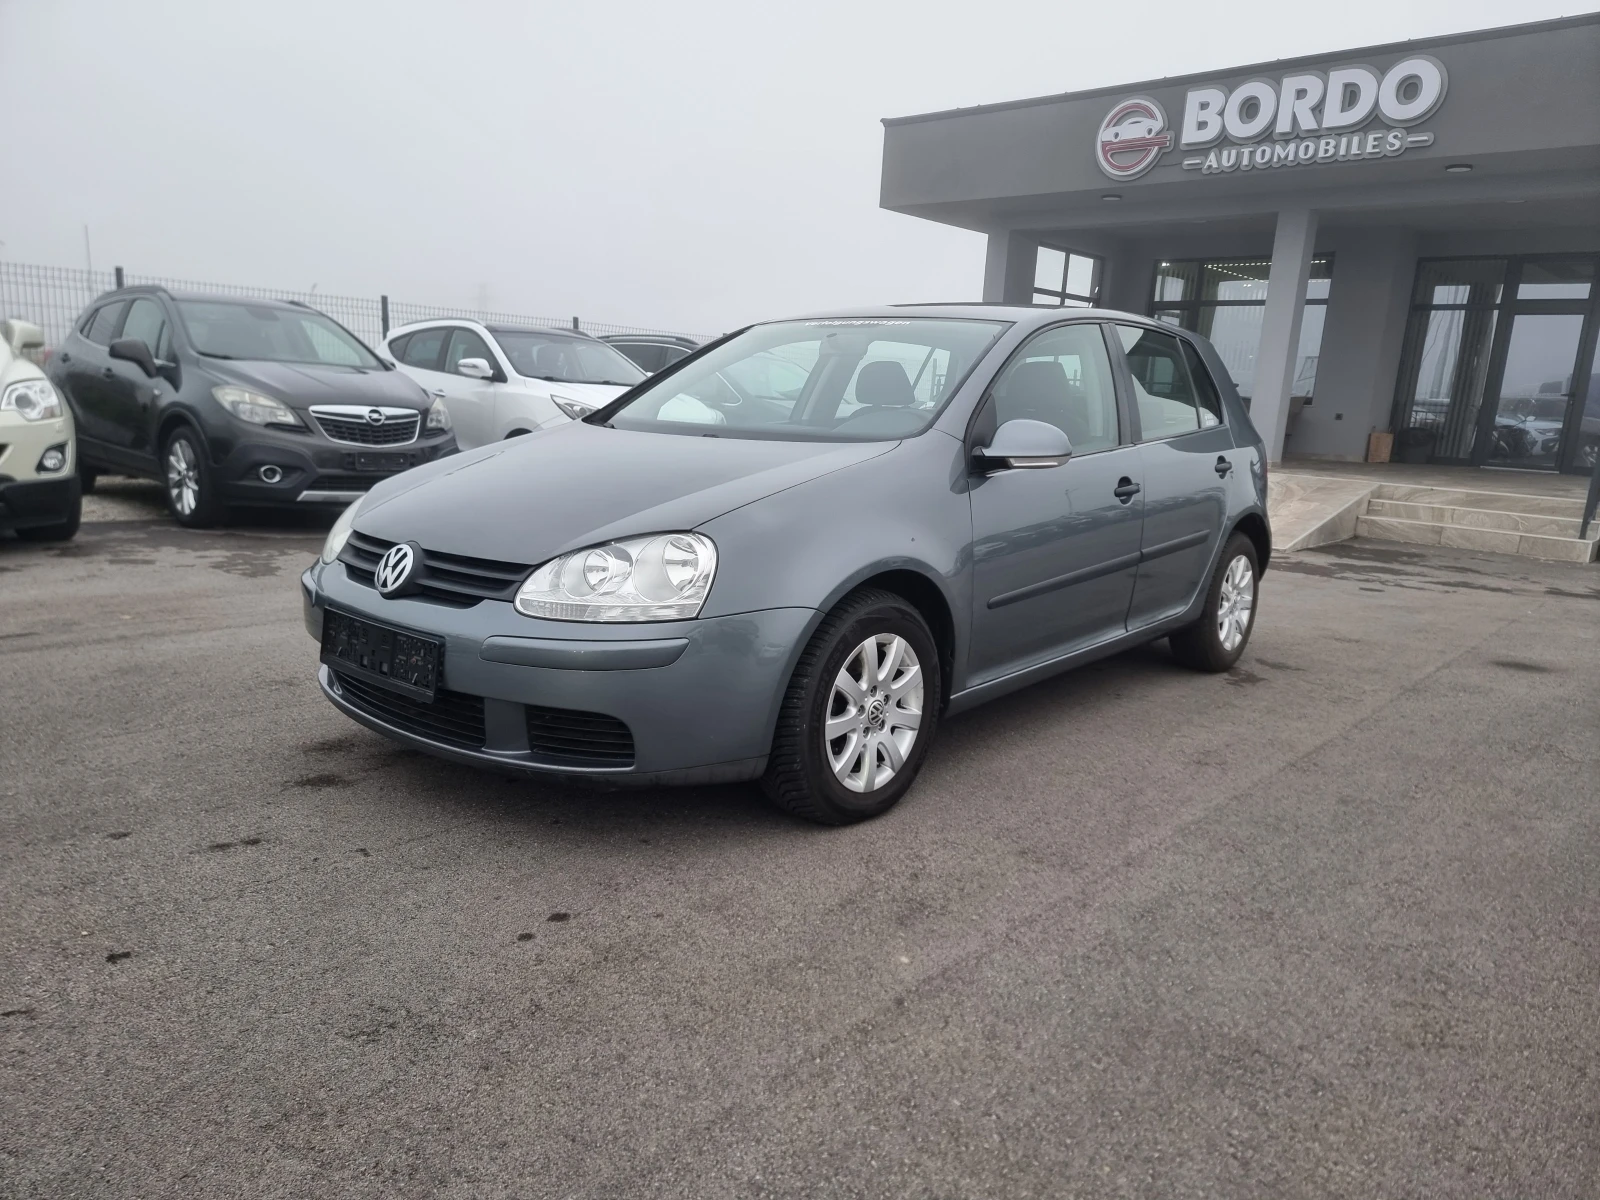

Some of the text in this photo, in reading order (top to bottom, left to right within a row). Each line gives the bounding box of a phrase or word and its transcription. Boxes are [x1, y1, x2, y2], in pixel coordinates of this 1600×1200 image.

[1182, 58, 1442, 145] BORDO
[1203, 131, 1402, 169] AUTOMOBILES
[375, 543, 414, 593] VW
